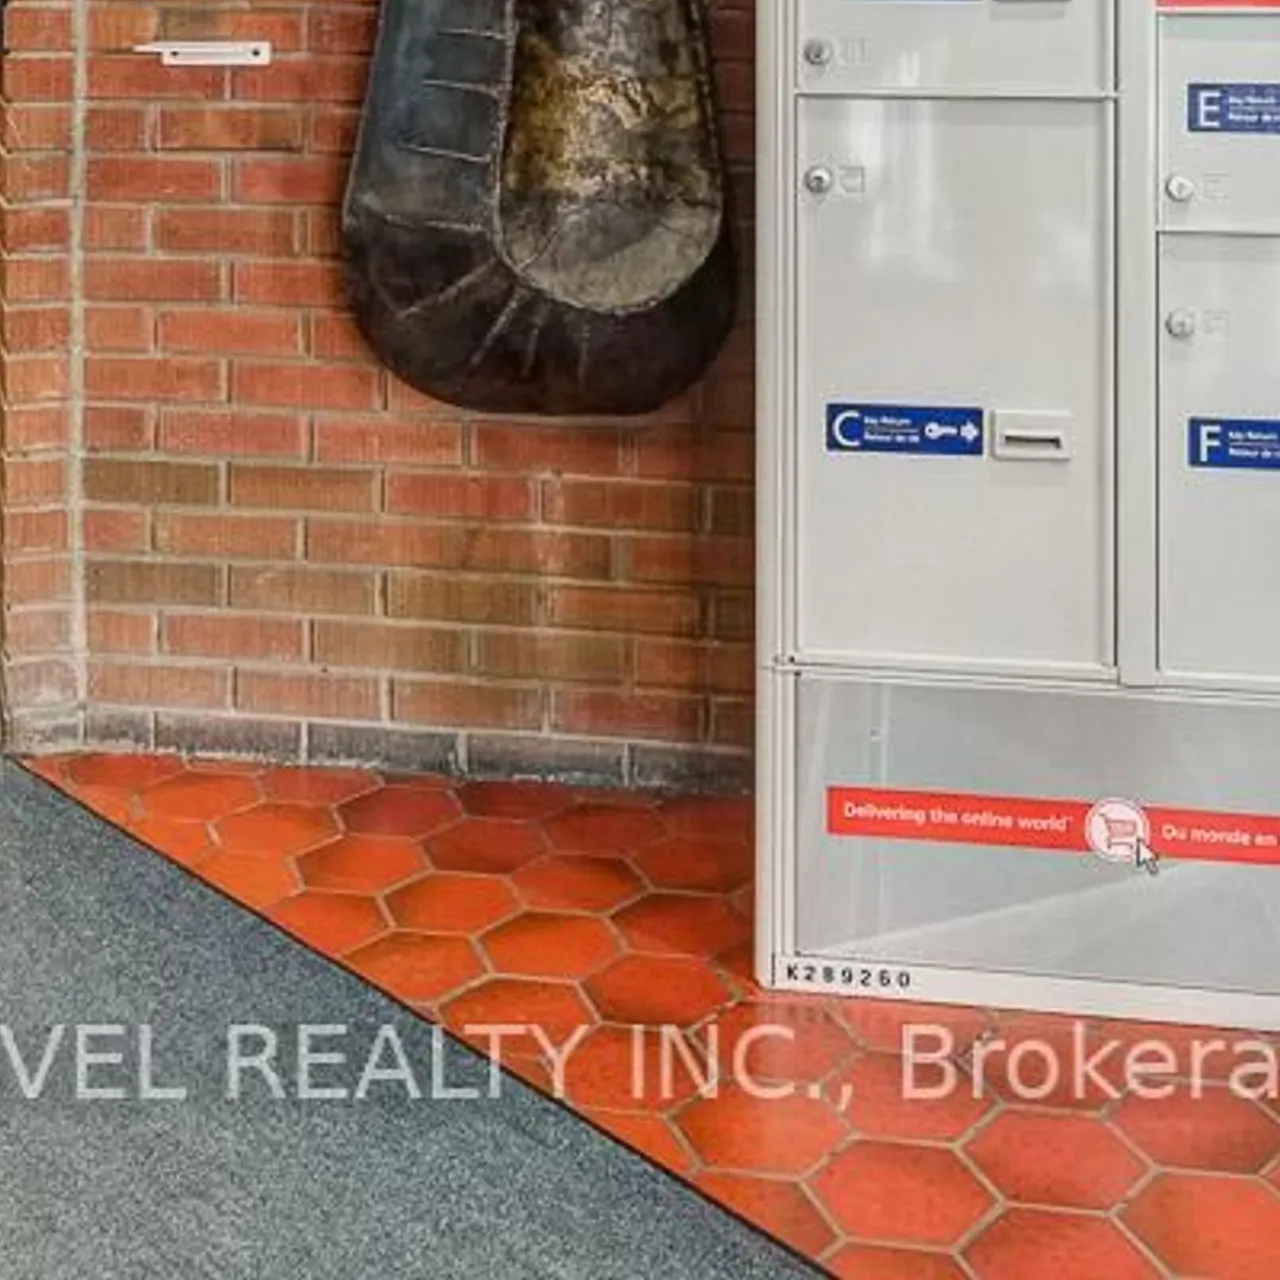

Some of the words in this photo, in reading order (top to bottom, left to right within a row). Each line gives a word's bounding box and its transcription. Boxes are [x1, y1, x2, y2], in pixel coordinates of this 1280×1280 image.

[1198, 90, 1220, 127] E
[832, 409, 861, 447] C
[1199, 425, 1221, 462] F
[844, 801, 926, 826] Delivering
[930, 806, 957, 824] the
[961, 809, 1013, 829] online
[1190, 826, 1251, 846] monde
[1255, 833, 1278, 848] en
